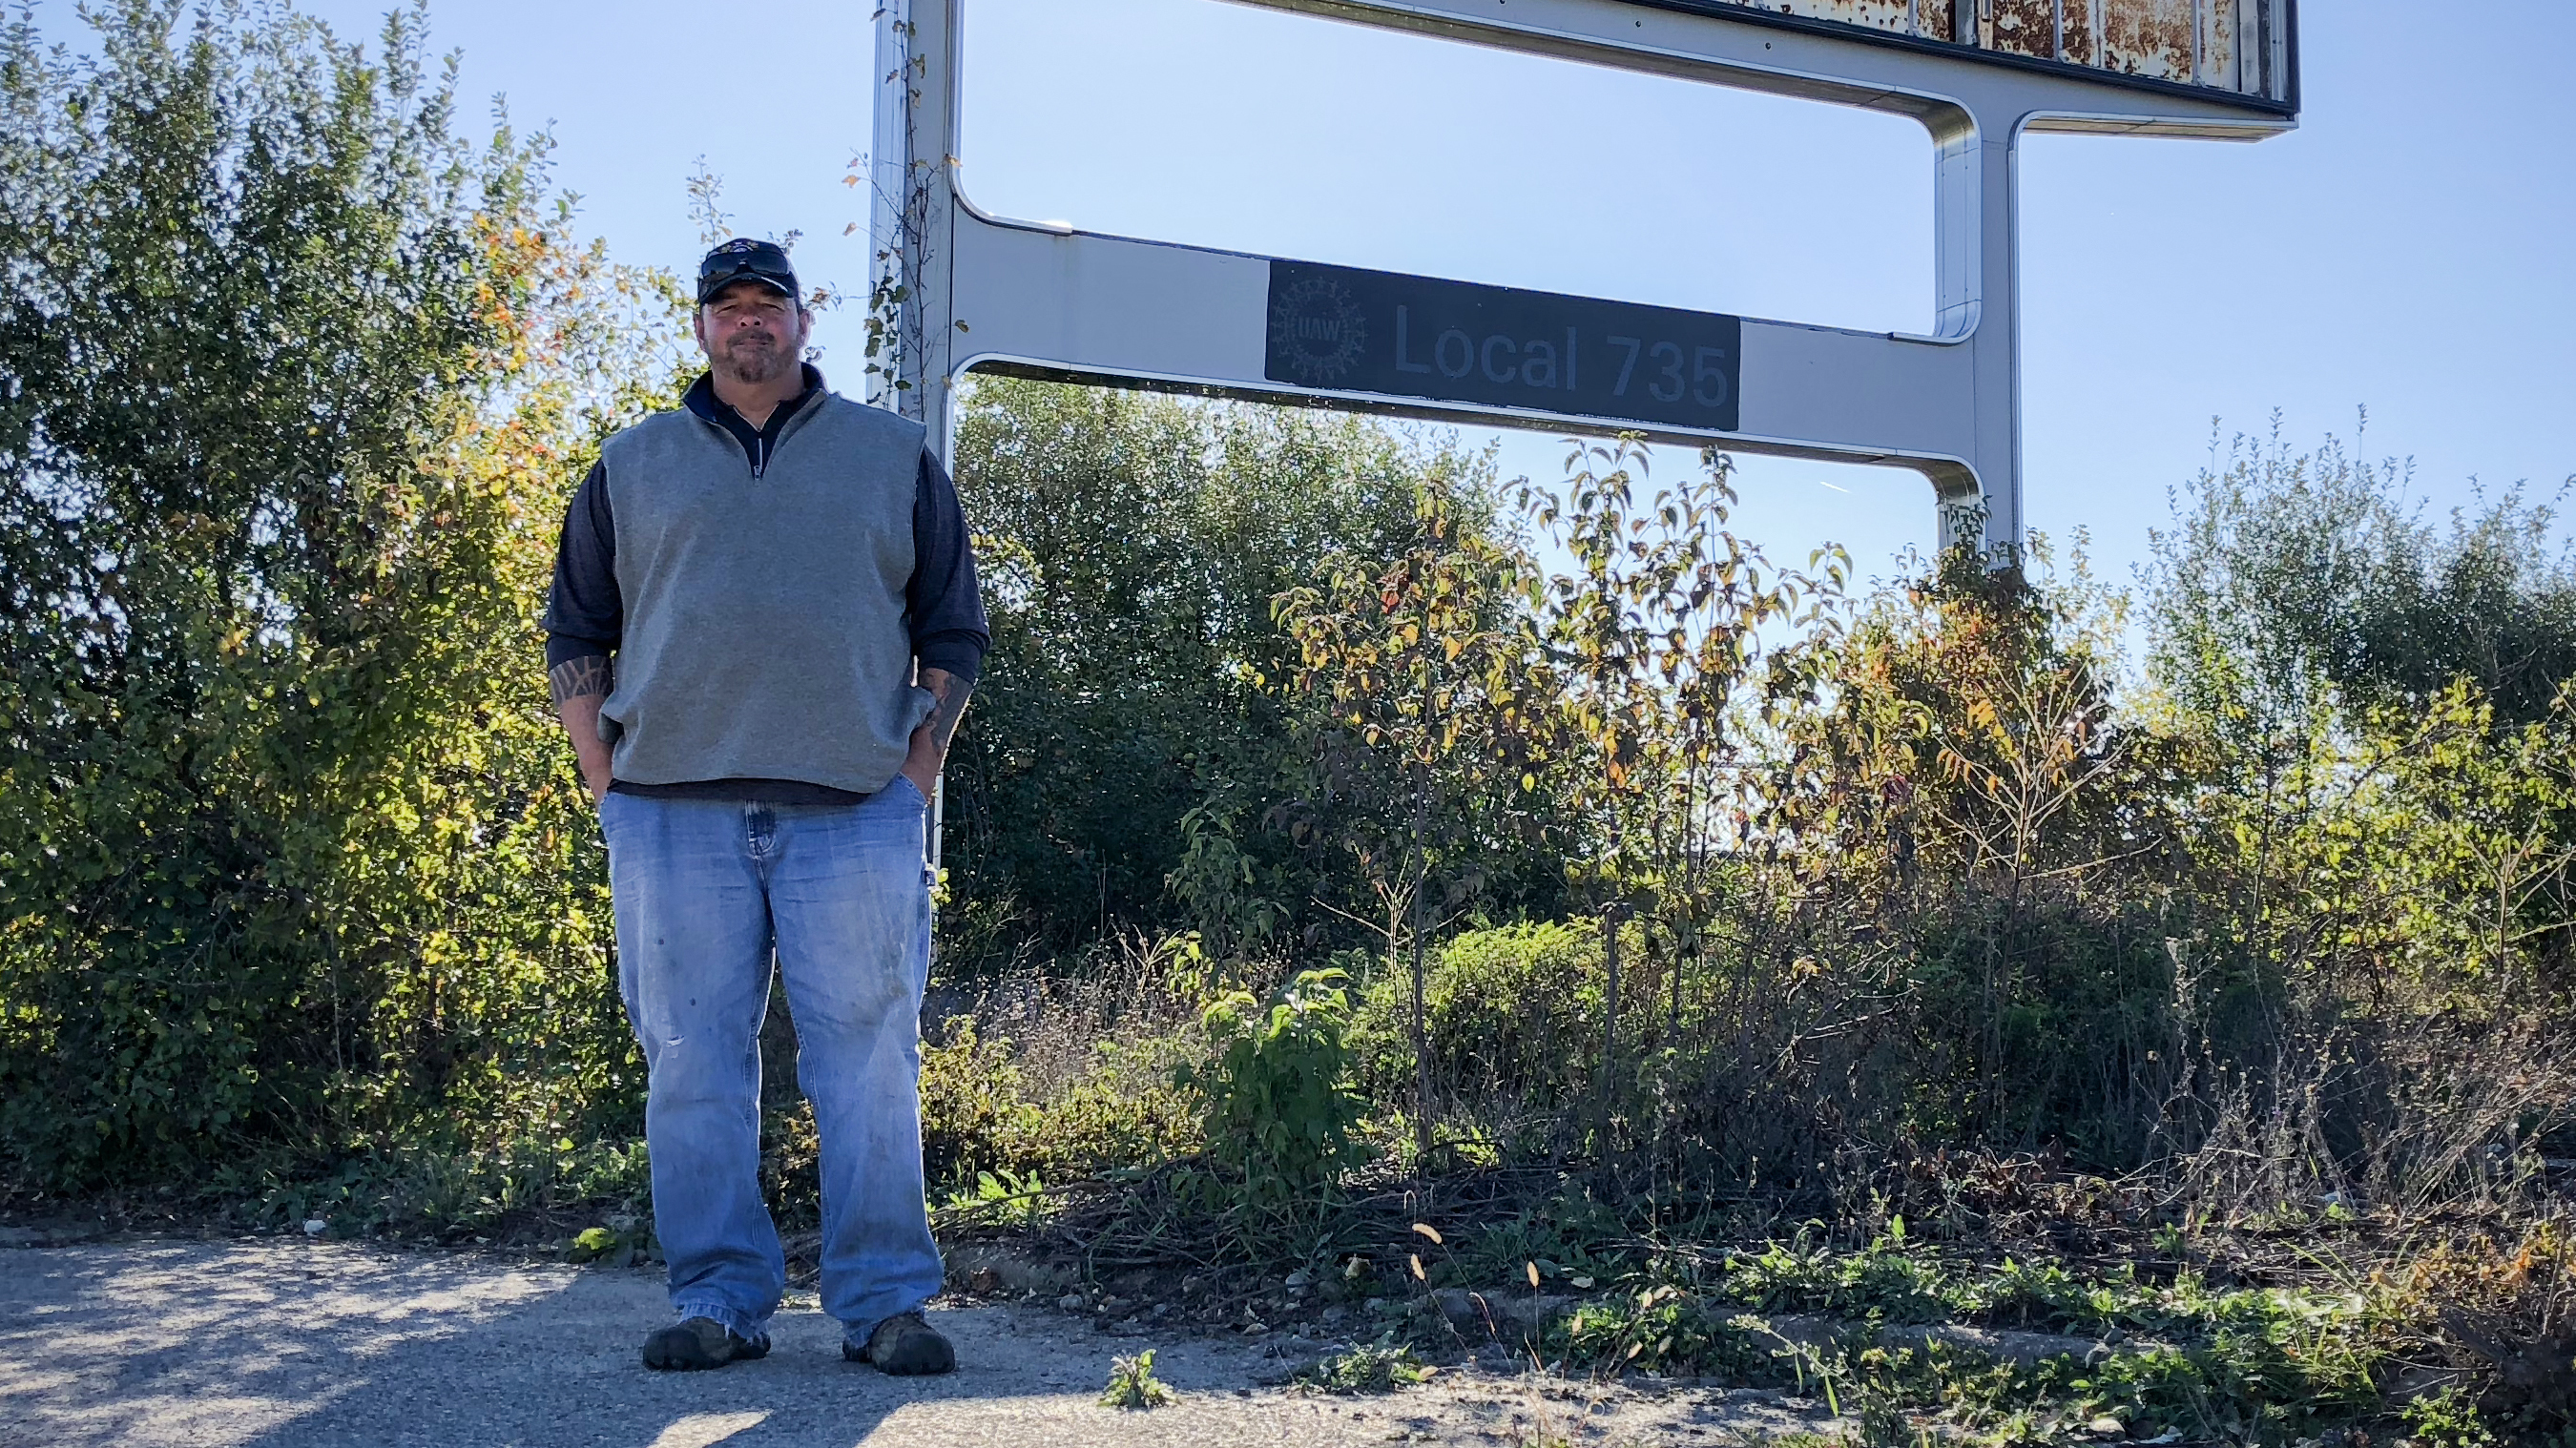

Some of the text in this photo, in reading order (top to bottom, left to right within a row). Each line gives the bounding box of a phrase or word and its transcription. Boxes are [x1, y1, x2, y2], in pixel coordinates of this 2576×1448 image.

[1298, 316, 1340, 341] UAW
[1395, 304, 1728, 408] Local 735
